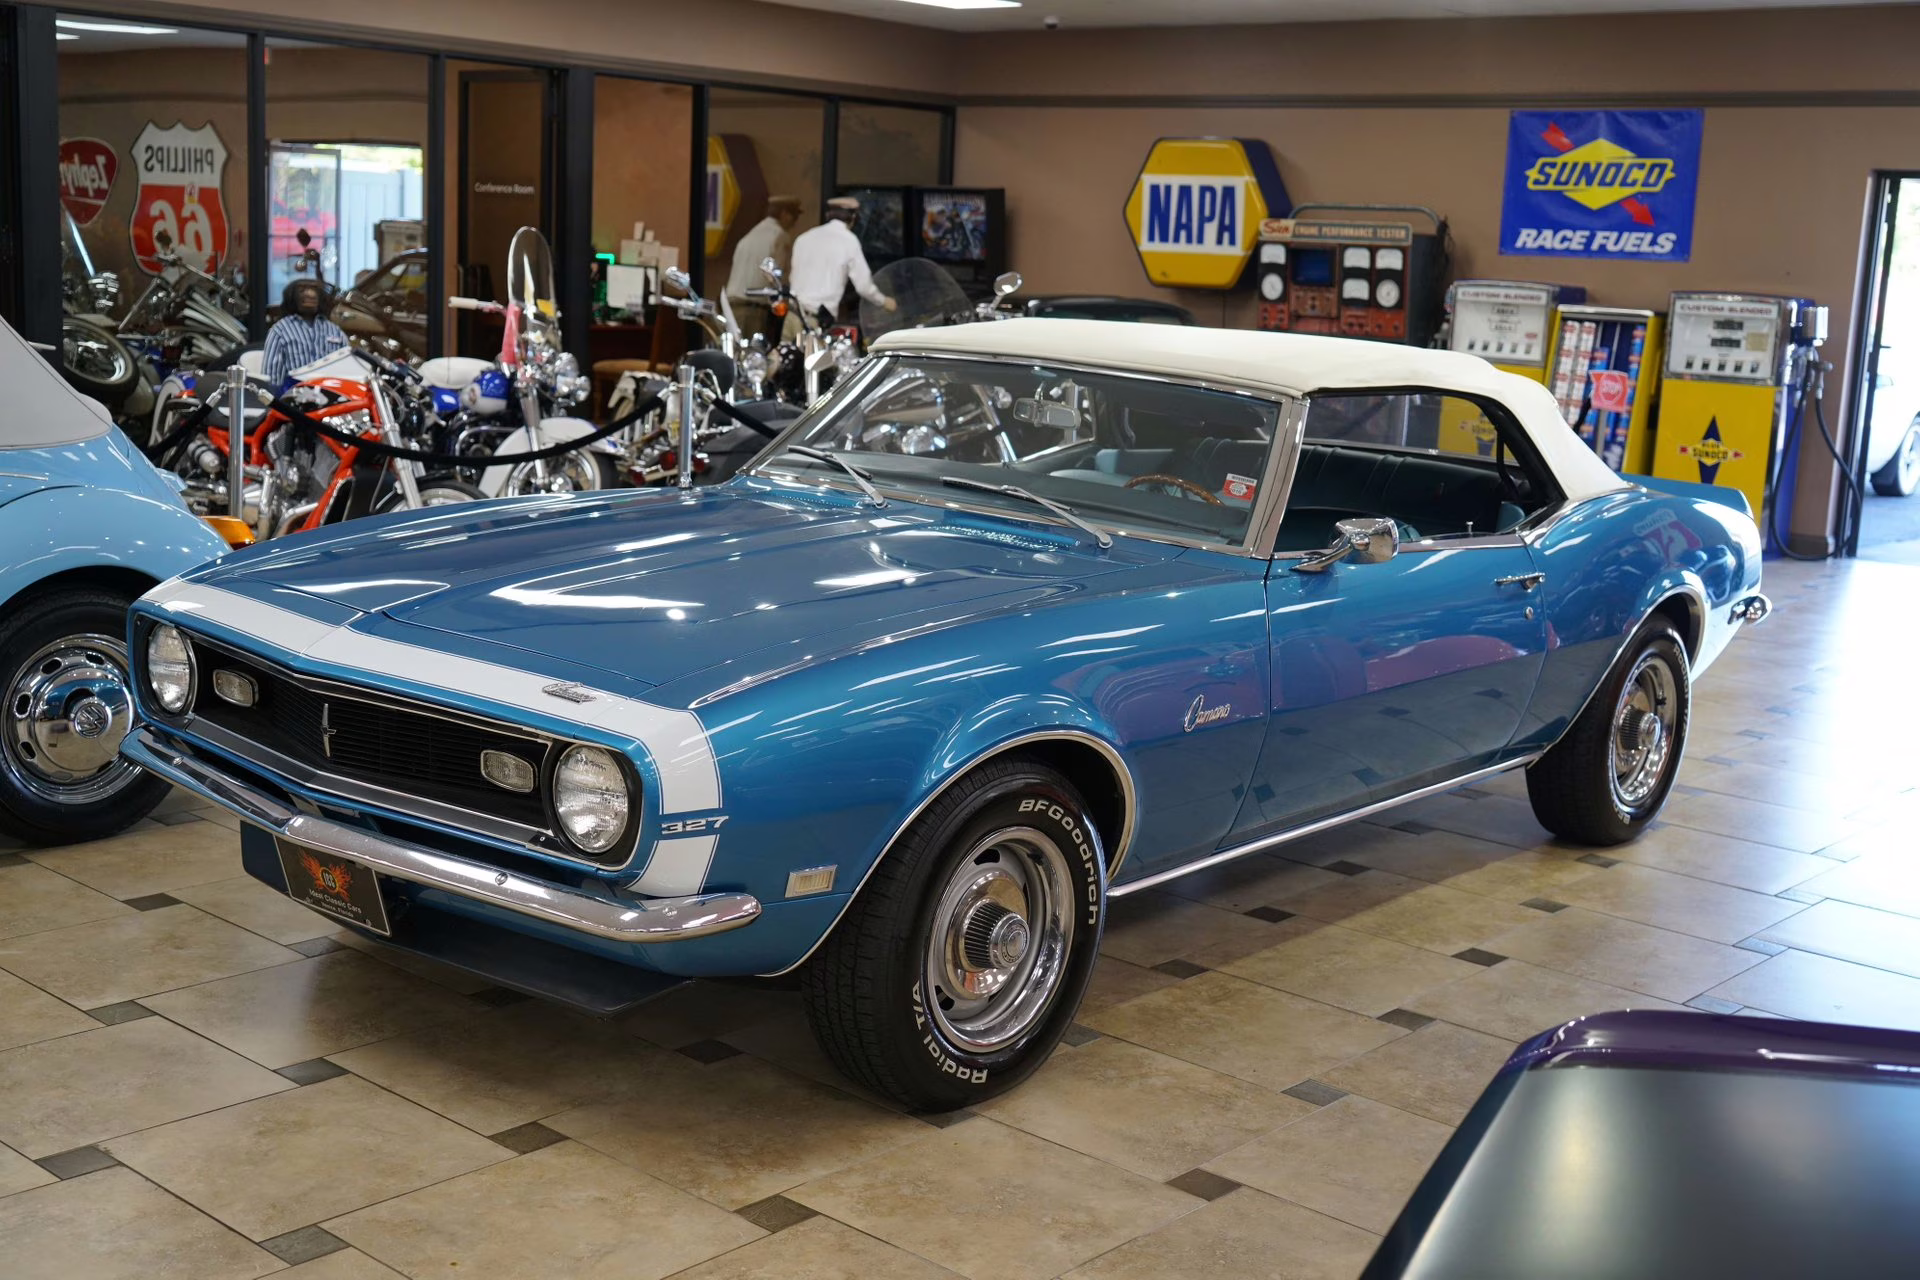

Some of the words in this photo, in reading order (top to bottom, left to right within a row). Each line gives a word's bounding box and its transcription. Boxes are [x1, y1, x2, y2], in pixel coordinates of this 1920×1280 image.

[1532, 162, 1669, 187] SUNOCO
[1148, 184, 1237, 246] NAPA
[1515, 227, 1590, 251] RACE
[1590, 231, 1677, 254] FUELS
[661, 815, 730, 835] 327
[1018, 799, 1098, 925] BFGoodrich
[923, 1033, 989, 1084] Radial
